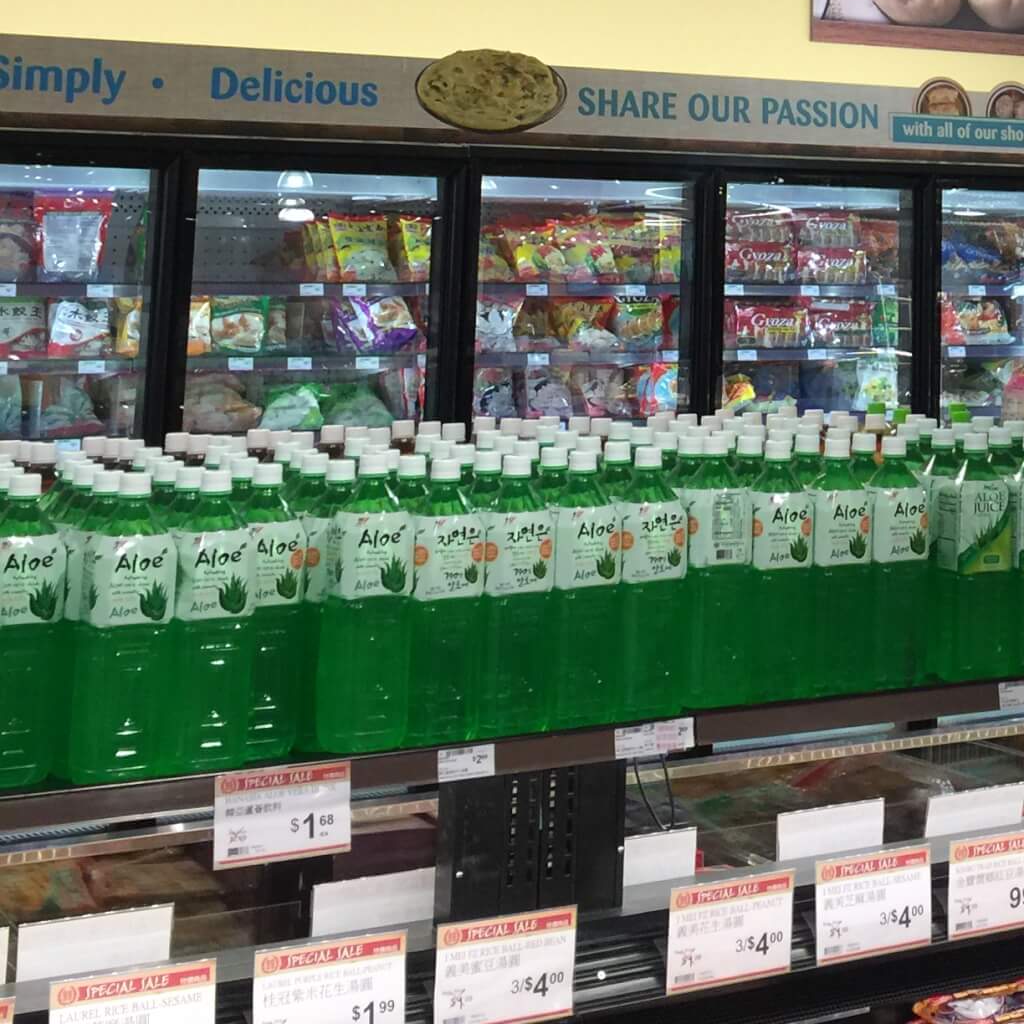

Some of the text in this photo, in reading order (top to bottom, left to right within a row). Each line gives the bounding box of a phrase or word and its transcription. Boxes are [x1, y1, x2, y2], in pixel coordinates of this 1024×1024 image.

[0, 55, 379, 107] Simply Delicious
[578, 87, 879, 130] SHARE OUR PASSION
[902, 121, 933, 138] with
[936, 122, 953, 139] all
[957, 122, 972, 139] of
[974, 128, 998, 141] our
[751, 313, 795, 328] Gyoza
[975, 492, 1005, 503] ALOE
[974, 502, 1005, 514] JUICE
[244, 775, 285, 789] SPECIAL
[839, 862, 877, 877] SPECIAL
[697, 889, 735, 905] SPECIAL
[466, 924, 510, 942] SPECIAL
[513, 919, 538, 934] SALE
[287, 951, 334, 969] SPECIAL
[336, 944, 364, 960] SALE
[85, 979, 137, 1000] SPECIAL
[140, 975, 169, 992] SALE
